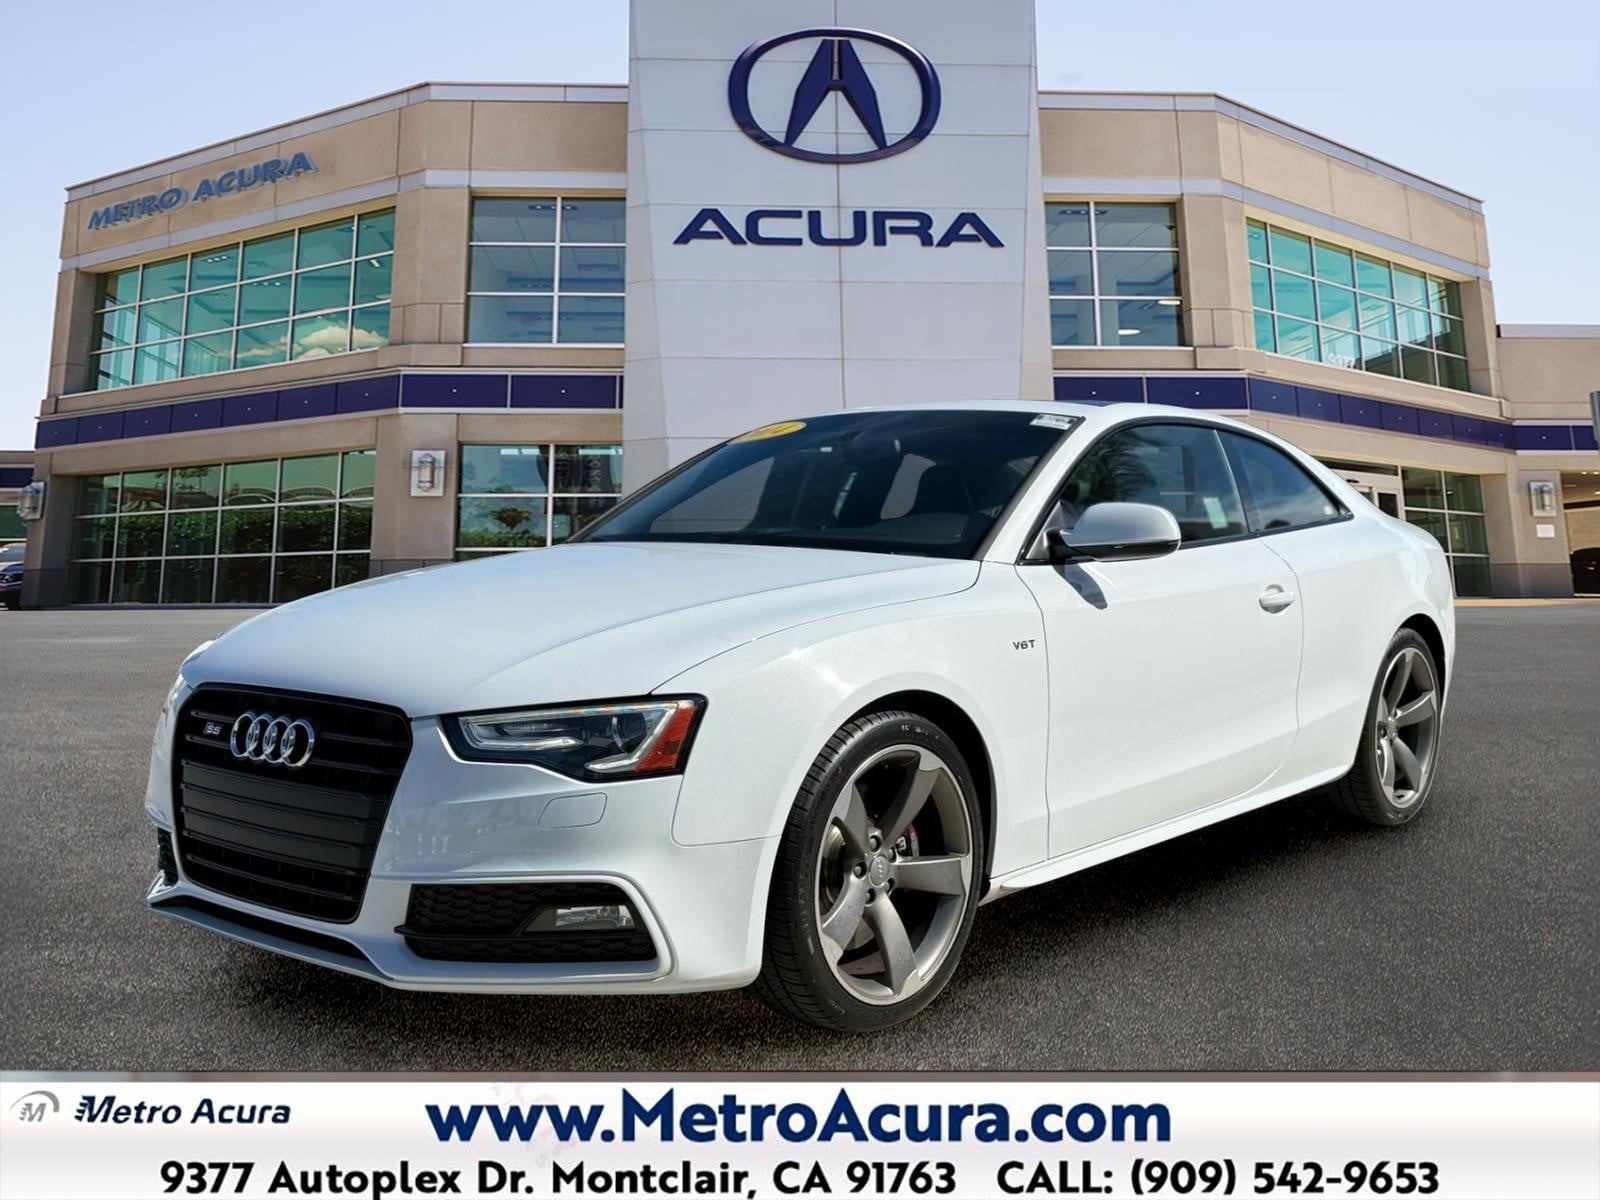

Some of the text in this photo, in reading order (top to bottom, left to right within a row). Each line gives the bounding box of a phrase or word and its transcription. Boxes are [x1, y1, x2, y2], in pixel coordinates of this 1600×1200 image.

[87, 151, 318, 230] METRO ACURA
[672, 207, 1006, 249] ACURA
[1012, 639, 1036, 650] V6T
